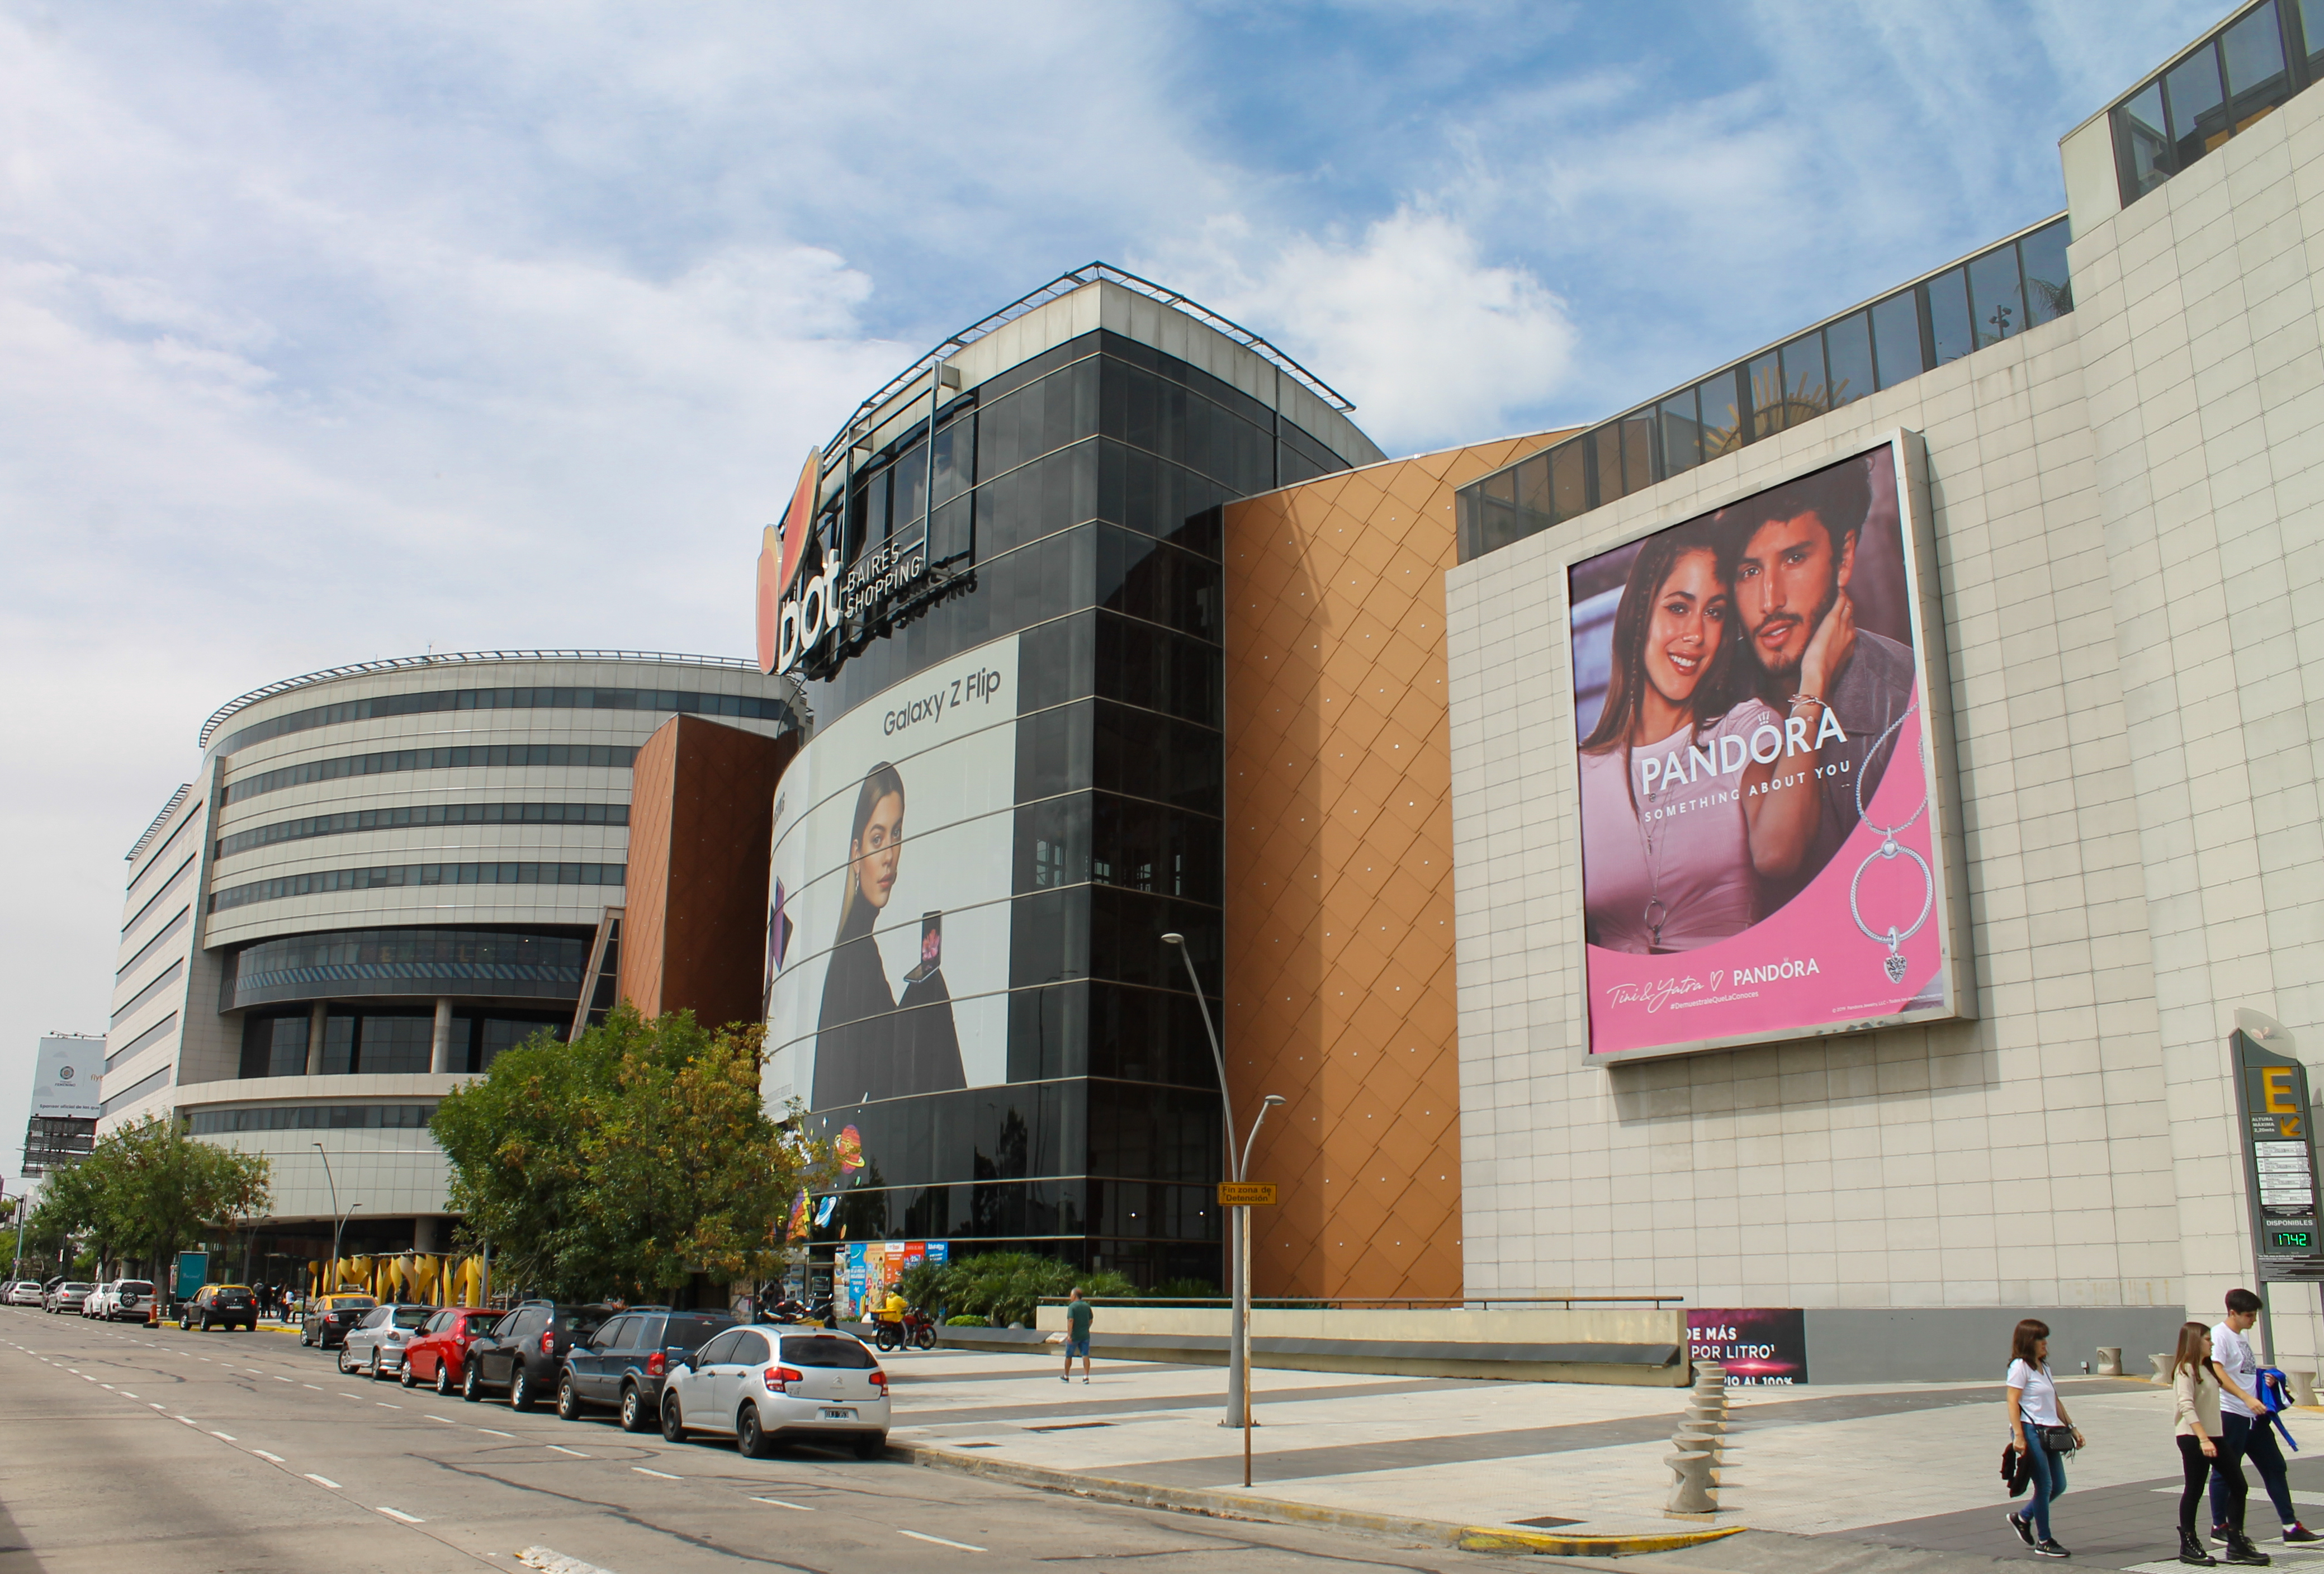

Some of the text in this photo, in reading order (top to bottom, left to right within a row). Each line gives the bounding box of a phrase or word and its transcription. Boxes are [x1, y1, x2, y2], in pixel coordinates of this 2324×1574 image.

[847, 542, 900, 593] BAIRES
[845, 556, 924, 618] SHOPPING
[883, 668, 1001, 736] Galaxy Z Flip
[1642, 707, 1847, 795] PANDORA
[1645, 759, 1850, 823] SOMETHING ABOUT YOU
[1733, 958, 1820, 986] PANDORA
[1670, 991, 1759, 1010] #DemuestraleQueLaConoces
[2261, 1066, 2297, 1113] E
[2279, 1233, 2307, 1246] 1742
[1706, 1324, 1738, 1340] MÁS
[1692, 1345, 1721, 1358] POR
[1744, 1377, 1757, 1386] AL
[1762, 1376, 1793, 1386] 100%
